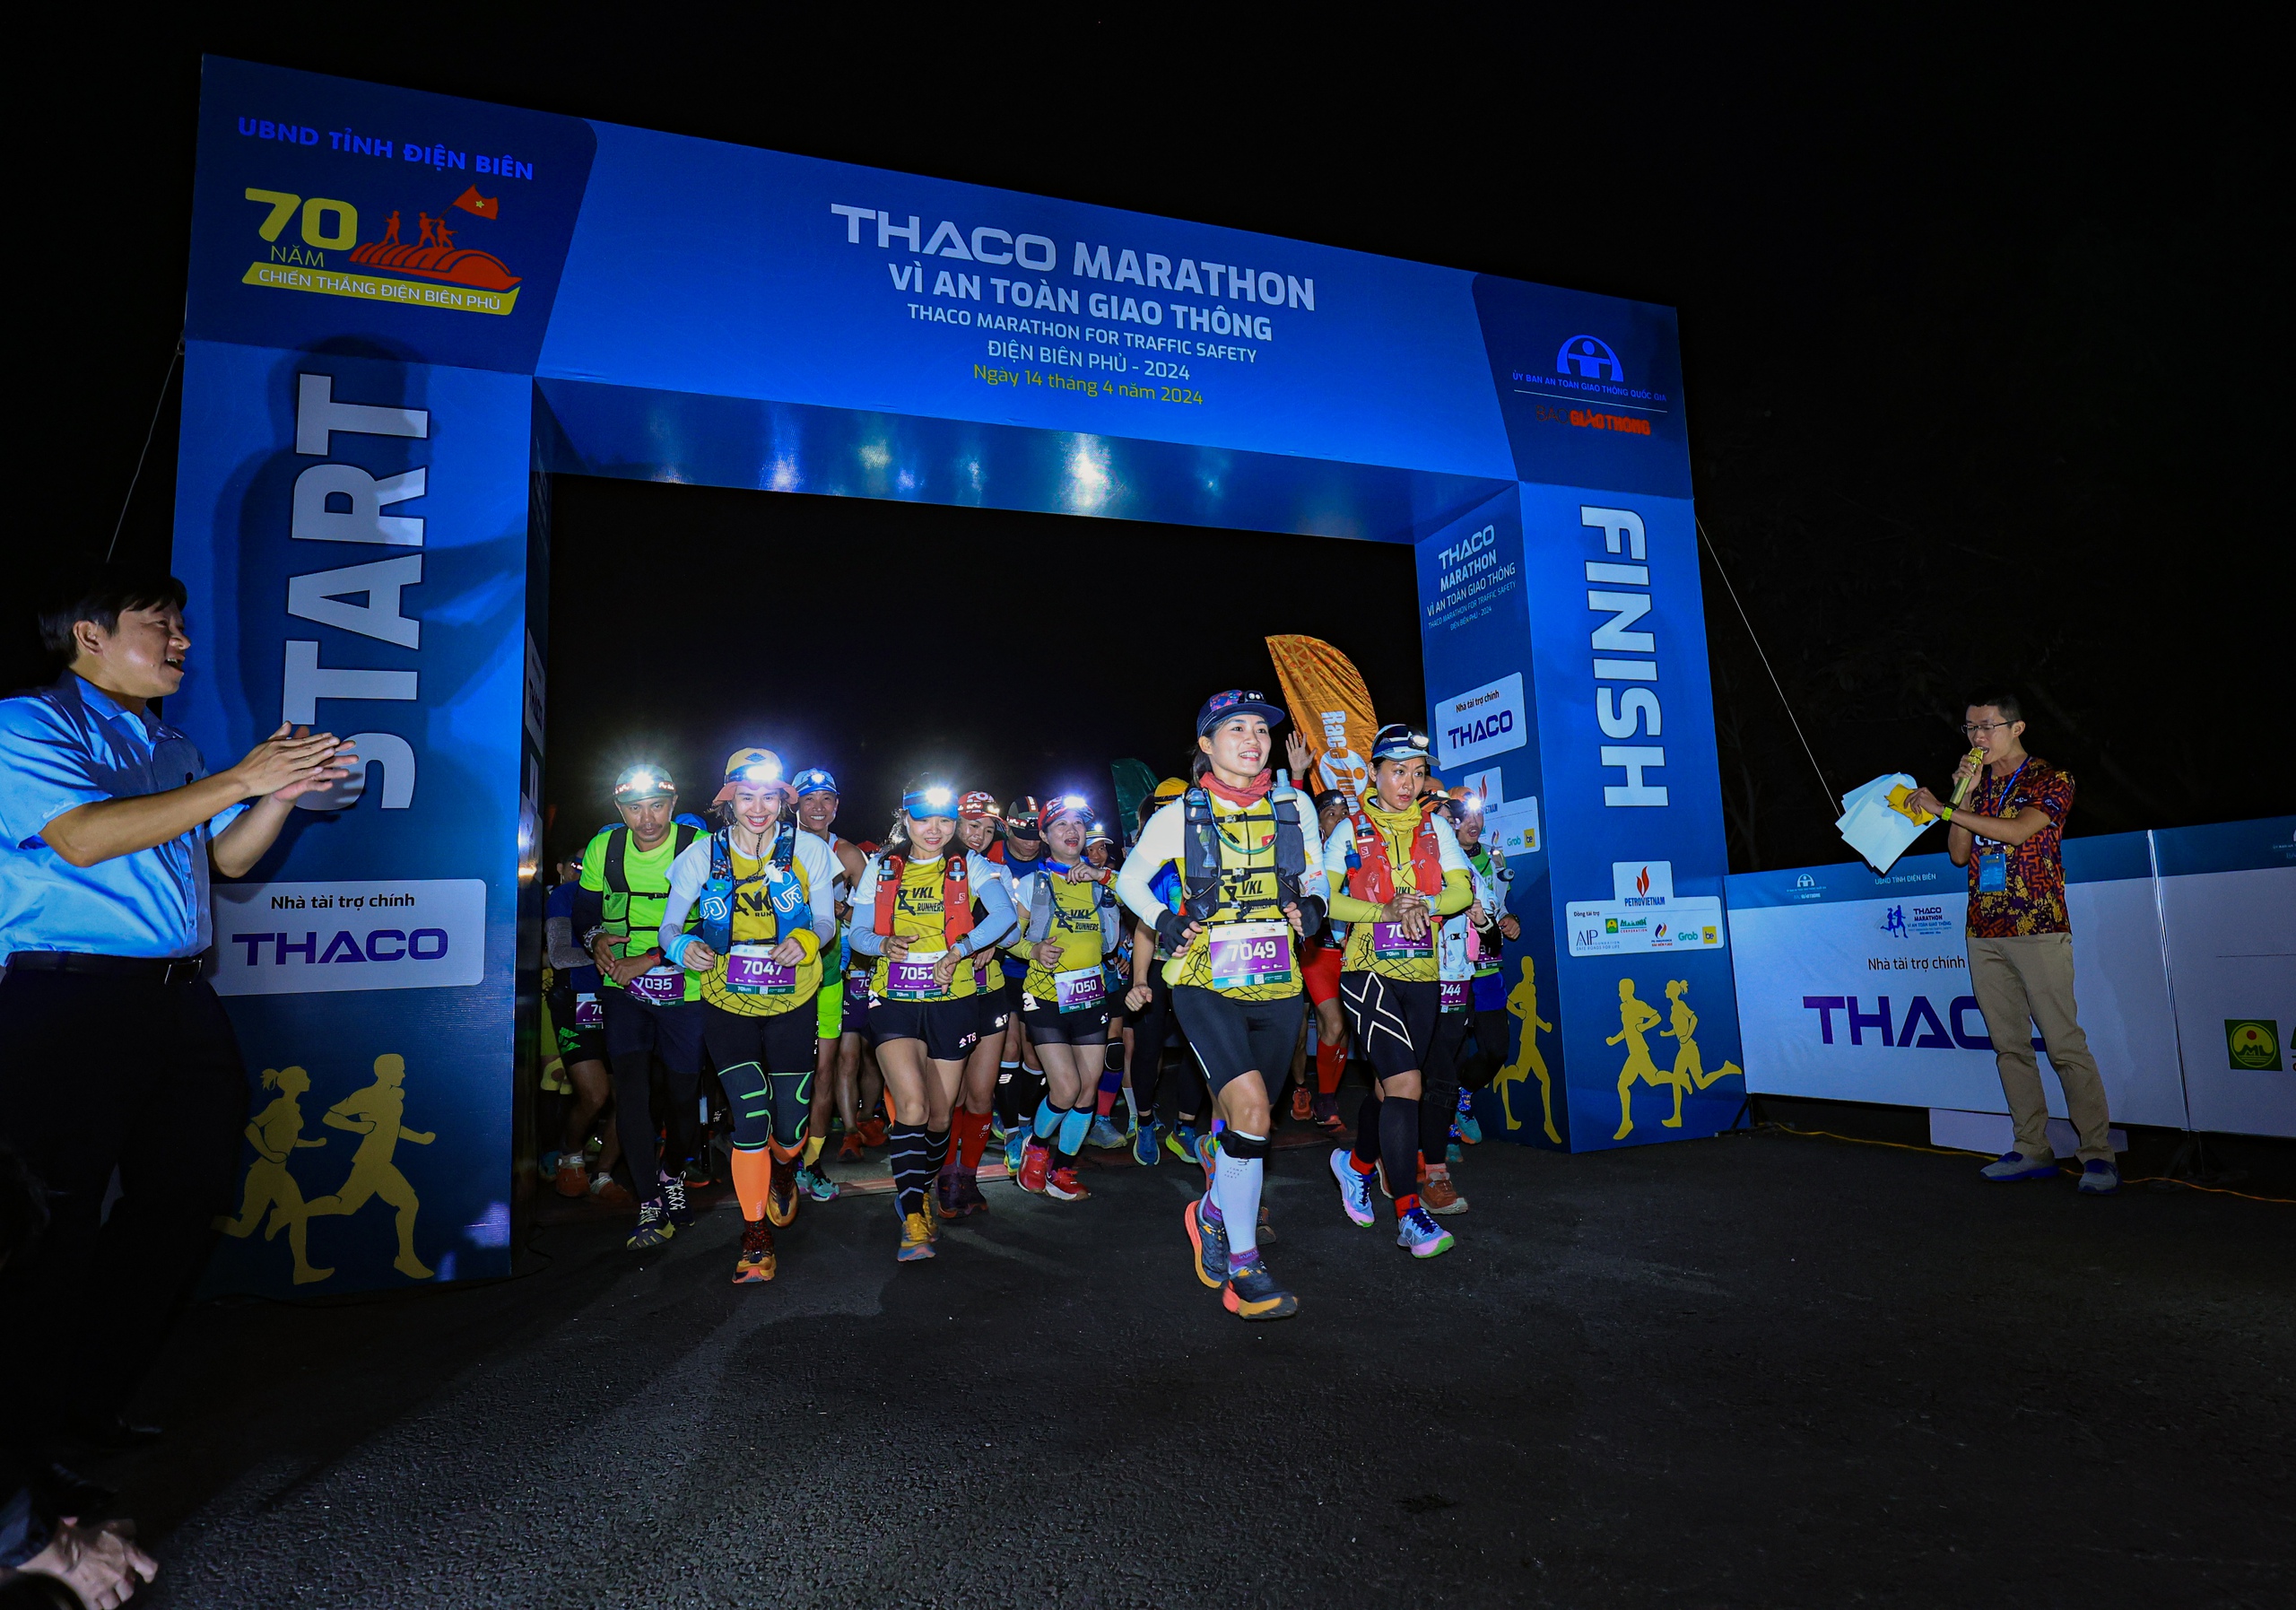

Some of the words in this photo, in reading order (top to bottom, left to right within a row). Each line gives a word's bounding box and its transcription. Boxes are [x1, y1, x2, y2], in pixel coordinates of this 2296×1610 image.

[238, 117, 319, 147] UBND
[328, 126, 393, 158] TỈNH
[404, 142, 465, 171] ĐIỆN
[475, 152, 534, 180] BIÊN
[244, 186, 358, 251] 70
[270, 245, 324, 268] NĂM
[831, 203, 1057, 272] THACO
[1073, 240, 1315, 312] MARATHON
[258, 267, 311, 288] CHIẾN
[317, 273, 376, 296] THẮNG
[381, 283, 420, 304] ĐIỆN
[424, 286, 462, 306] BIÊN
[466, 291, 500, 310] PHỦ
[888, 260, 922, 293] VÌ
[933, 270, 980, 301] AN
[990, 278, 1079, 315] TOÀN
[1089, 292, 1162, 326] GIAO
[1170, 303, 1273, 342] THÔNG
[907, 303, 971, 326] THACO
[976, 310, 1080, 341] MARATHON
[1085, 326, 1119, 346] FOR
[1123, 330, 1192, 355] TRAFFIC
[1196, 342, 1257, 365] SAFETY
[987, 339, 1033, 362] ĐIỆN
[1039, 342, 1083, 367] BIÊN
[1089, 350, 1126, 374] PHỦ
[1144, 359, 1190, 381] 2024
[973, 363, 1020, 389] Ngày
[1024, 369, 1042, 387] 14
[1048, 371, 1098, 398] tháng
[1102, 379, 1114, 396] 4
[1118, 381, 1156, 400] năm
[1161, 385, 1203, 405] 2024
[1526, 373, 1544, 384] BAN
[1544, 377, 1556, 386] AN
[1558, 379, 1579, 389] TOÀN
[1581, 382, 1601, 392] GIAO
[1601, 385, 1629, 396] THÔNG
[1630, 388, 1652, 400] QUỐC
[1653, 393, 1668, 402] GIA
[1438, 524, 1495, 570] THACO
[1440, 549, 1497, 593] MARATHON
[1427, 601, 1435, 617] VÌ
[1435, 598, 1446, 614] AN
[1447, 587, 1467, 607] TOÀN
[1468, 578, 1486, 596] GIAO
[1487, 561, 1516, 587] THÔNG
[1428, 617, 1442, 630] THACO
[1443, 605, 1467, 623] MARATHON
[1467, 599, 1477, 610] FOR
[1478, 589, 1497, 605] TRAFFIC
[1498, 579, 1517, 596] SAFETY
[1481, 606, 1492, 617] 2024
[1580, 504, 1669, 807] FINISH
[1456, 701, 1466, 713] Nhà
[1474, 696, 1483, 706] trợ
[1484, 690, 1500, 702] chính
[1448, 709, 1513, 749] THACO
[1507, 835, 1521, 847] Grab
[1241, 881, 1263, 895] VKL
[1874, 877, 1891, 885] UBND
[1907, 874, 1921, 883] ĐIỆN
[1922, 873, 1936, 882] BIÊN
[271, 895, 306, 909] Nhà
[311, 895, 334, 909] tài
[338, 895, 365, 911] trợ
[369, 892, 415, 908] chính
[912, 887, 934, 898] VKL
[1624, 896, 1665, 908] PETROVIETNAM
[917, 902, 944, 912] RUNNERS
[1913, 907, 1942, 915] THACO
[1074, 922, 1100, 932] RUNNERS
[1576, 929, 1598, 946] AIP
[1678, 930, 1699, 941] Grab
[1705, 930, 1714, 940] be
[232, 928, 448, 966] THACO
[1227, 940, 1276, 962] 7049
[1867, 956, 1892, 970] Nhà
[1894, 955, 1908, 970] tài
[1910, 956, 1930, 973] trợ
[1933, 953, 1966, 970] chính
[637, 976, 673, 990] 7035
[1070, 979, 1097, 996] 7050
[1803, 996, 2047, 1051] THAC
[967, 1032, 976, 1044] T8
